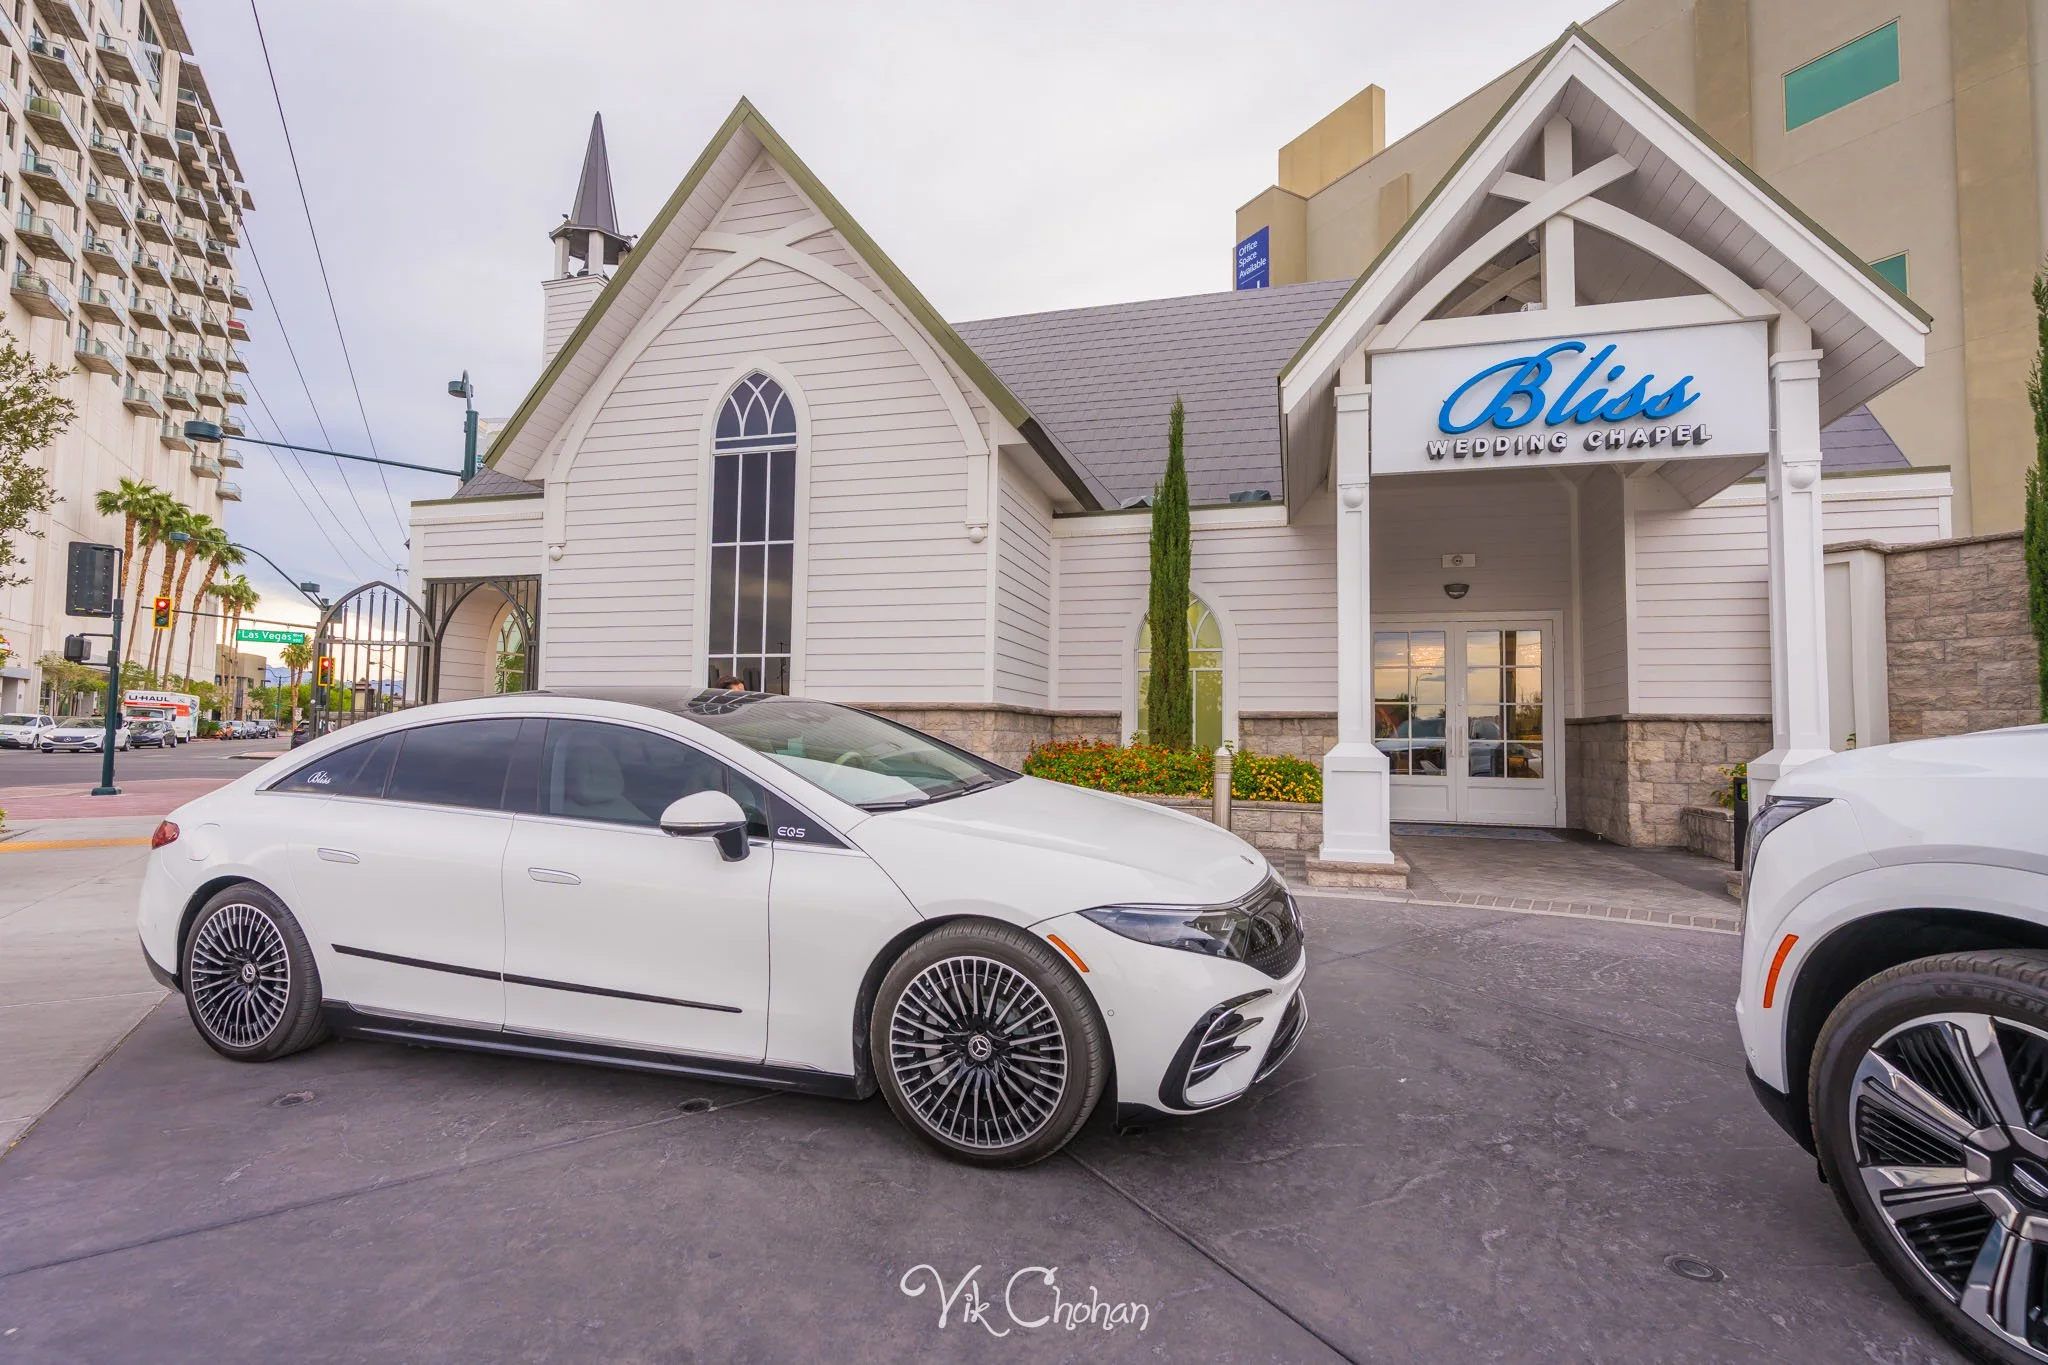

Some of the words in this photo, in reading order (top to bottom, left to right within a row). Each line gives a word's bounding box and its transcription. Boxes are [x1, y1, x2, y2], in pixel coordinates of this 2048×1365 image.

[1238, 240, 1258, 257] Office
[1238, 251, 1258, 268] Space
[1238, 257, 1267, 279] Available
[1438, 341, 1701, 435] Bliss
[1427, 432, 1568, 461] WEDDING
[1583, 424, 1713, 452] CHAPEL
[241, 630, 259, 639] Las
[262, 631, 292, 643] Vegas
[307, 770, 332, 785] Bliss
[777, 826, 806, 838] EQS
